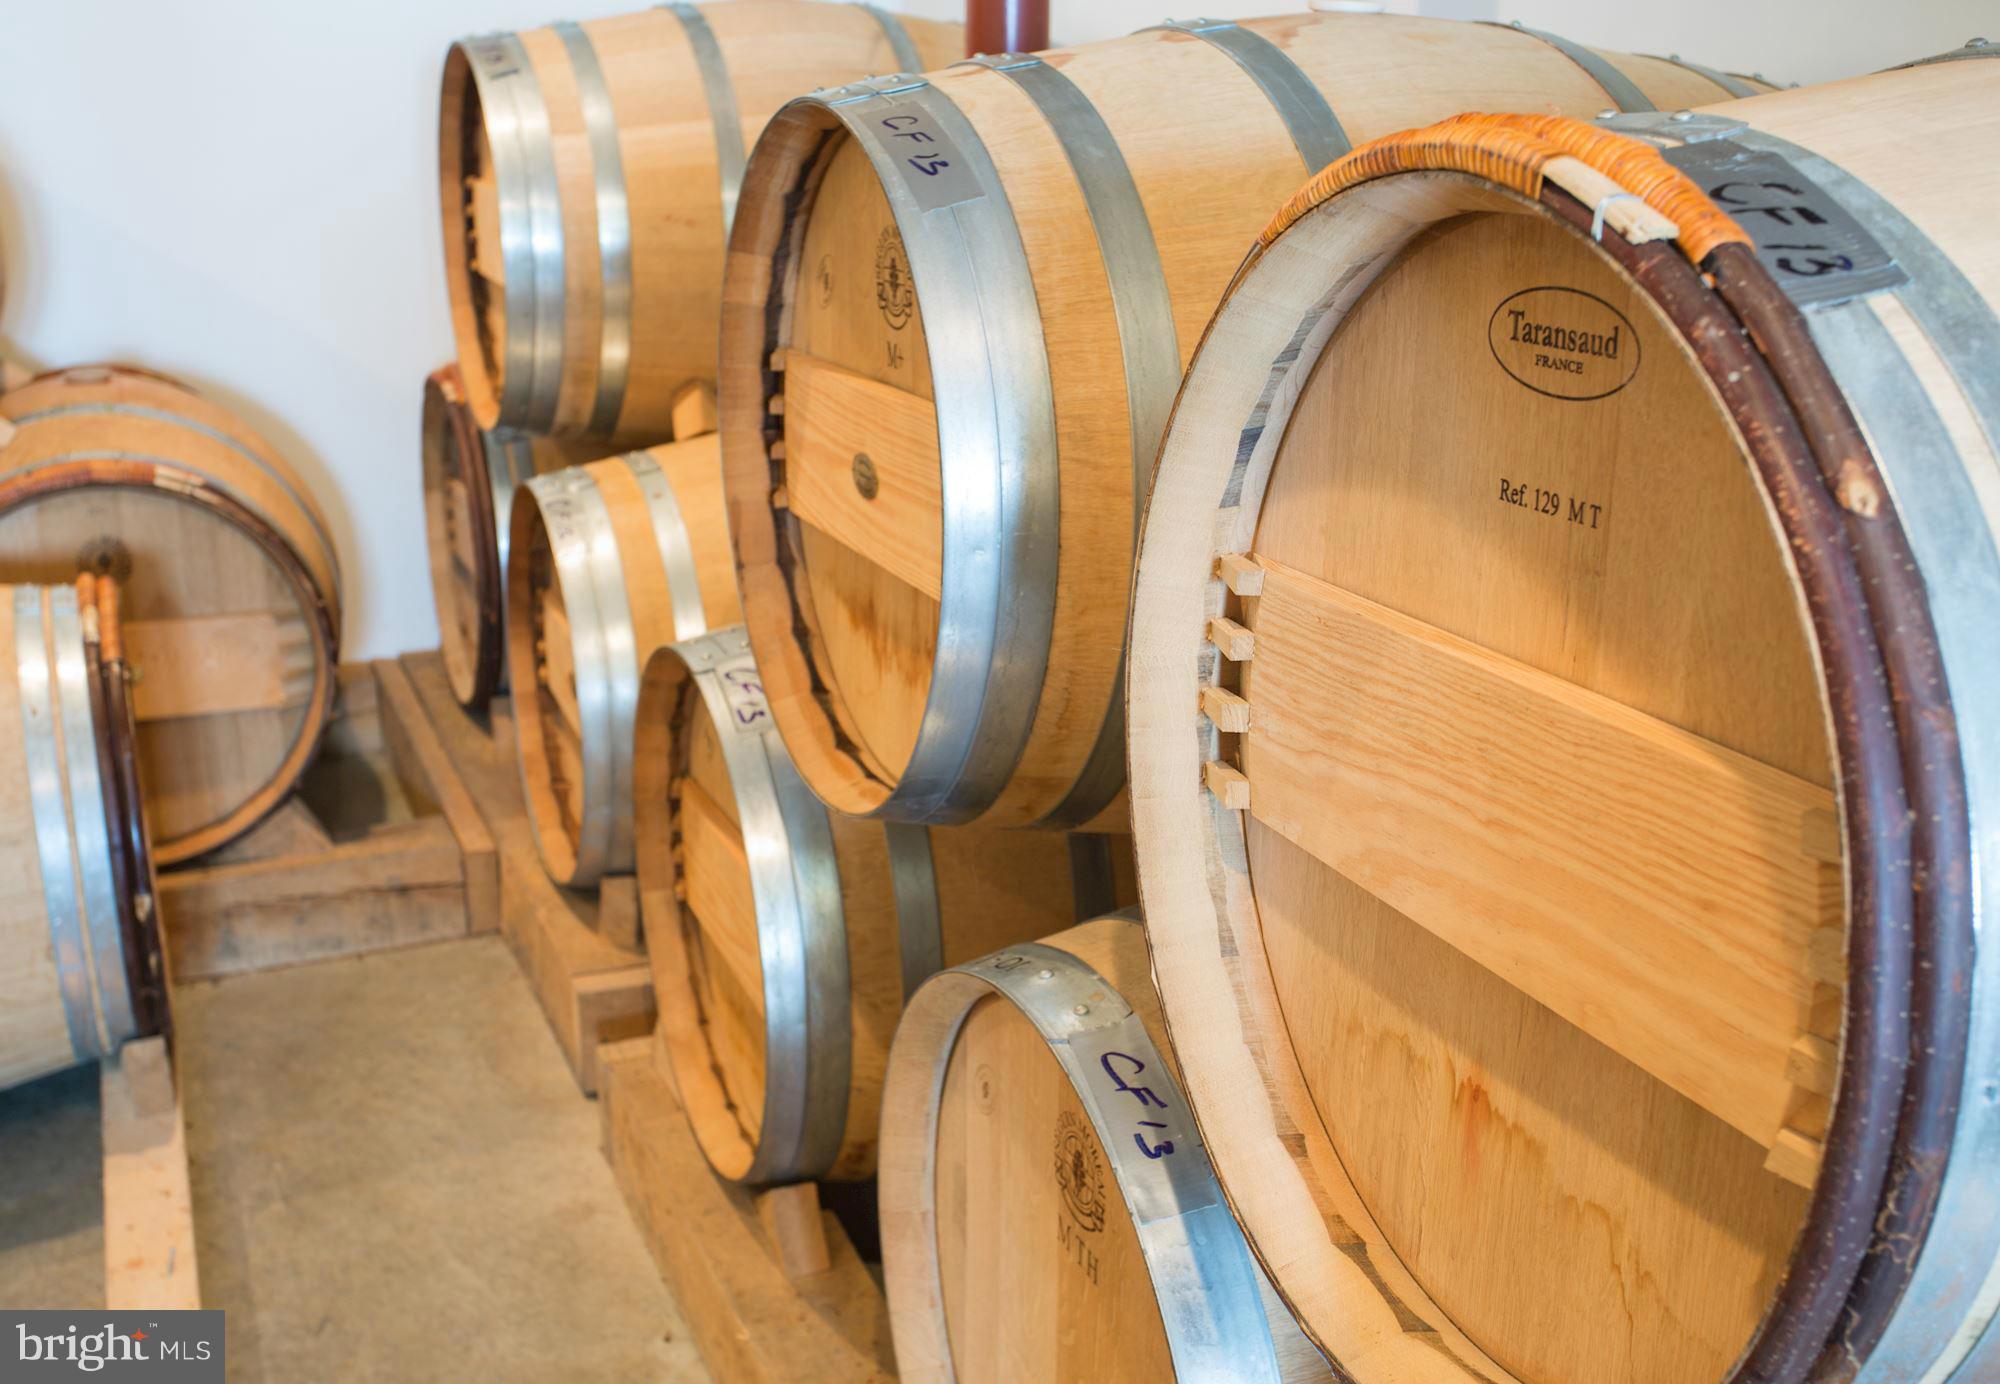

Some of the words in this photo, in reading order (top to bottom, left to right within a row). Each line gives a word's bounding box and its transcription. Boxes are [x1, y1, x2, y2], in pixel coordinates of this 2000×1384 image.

[881, 115, 935, 143] CF
[1708, 181, 1829, 226] CF
[1762, 244, 1854, 277] 13
[1507, 309, 1620, 360] Taransaud
[1534, 353, 1585, 375] FRANCE
[1499, 478, 1528, 508] Ref.
[1533, 487, 1561, 516] 129
[1099, 1051, 1169, 1110] CF
[1133, 1120, 1176, 1160] 13
